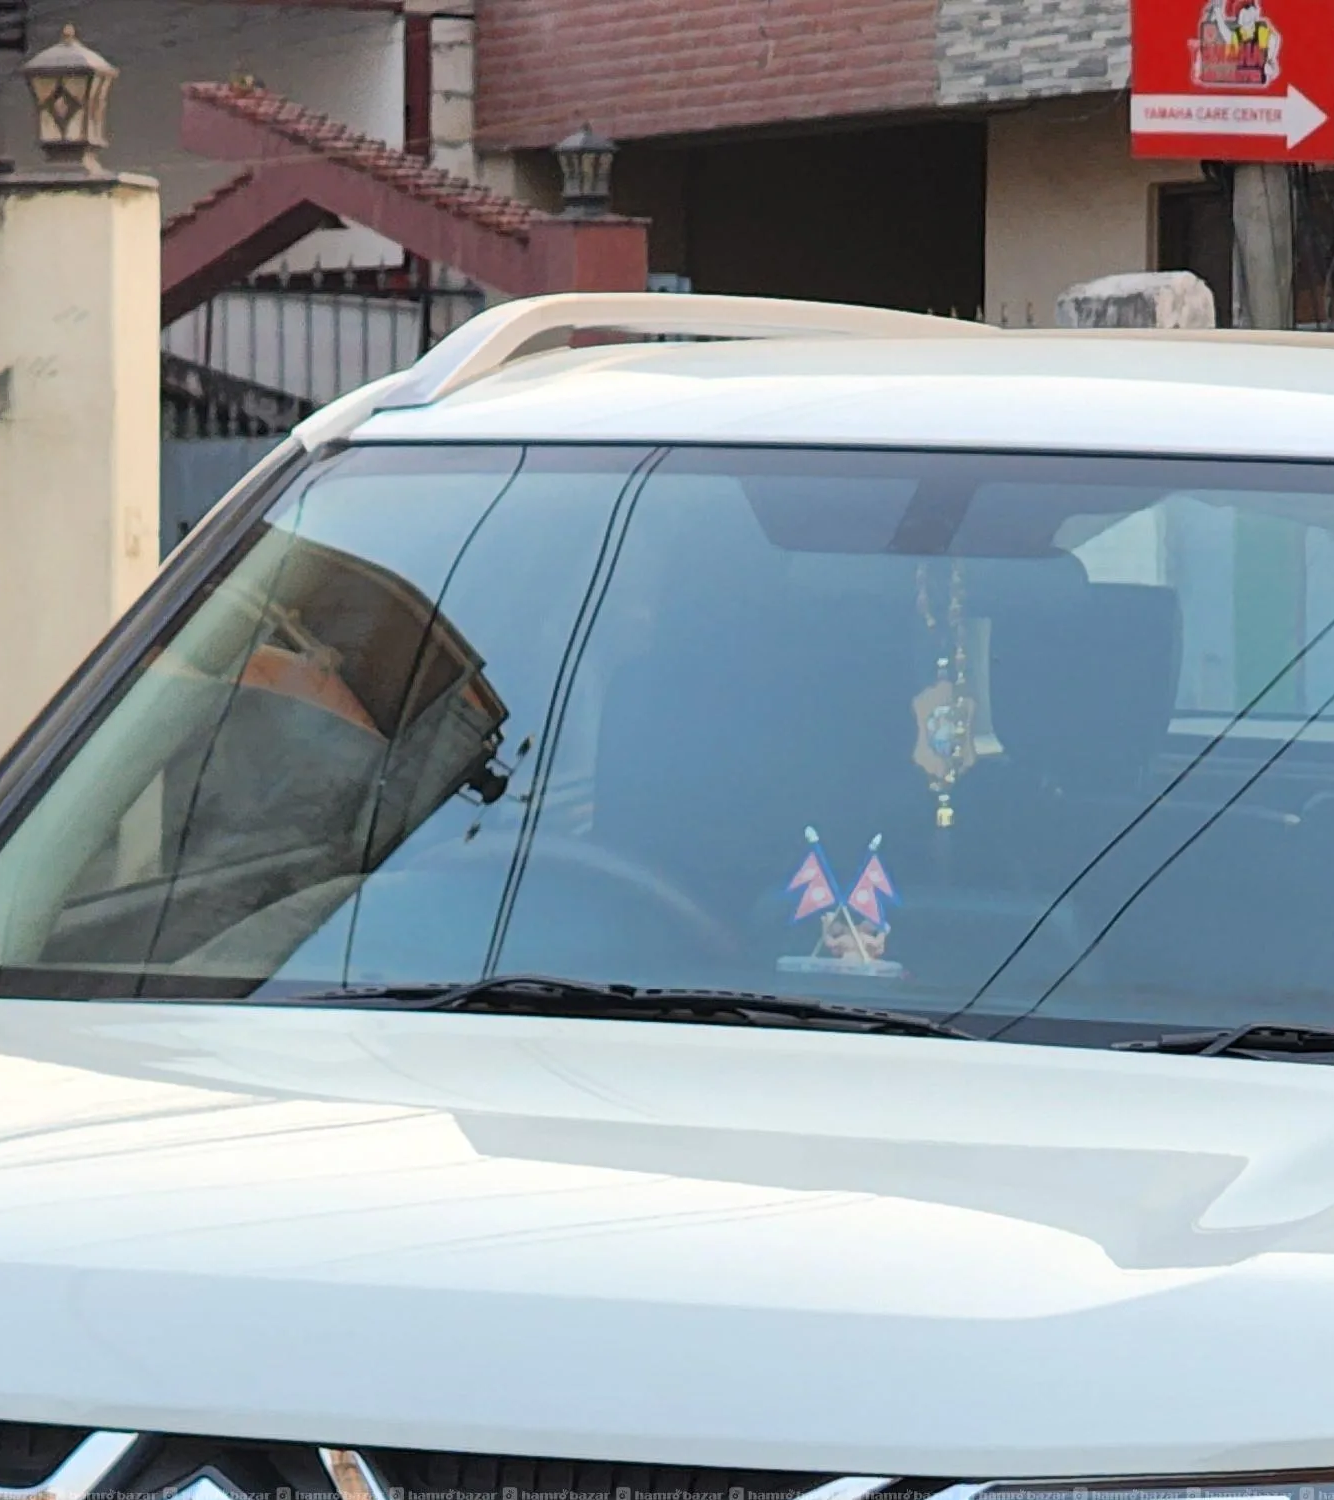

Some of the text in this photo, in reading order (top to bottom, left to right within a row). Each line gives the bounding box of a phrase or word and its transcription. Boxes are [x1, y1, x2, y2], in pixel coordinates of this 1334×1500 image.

[1143, 107, 1283, 122] YAMAHA CARE CENTER
